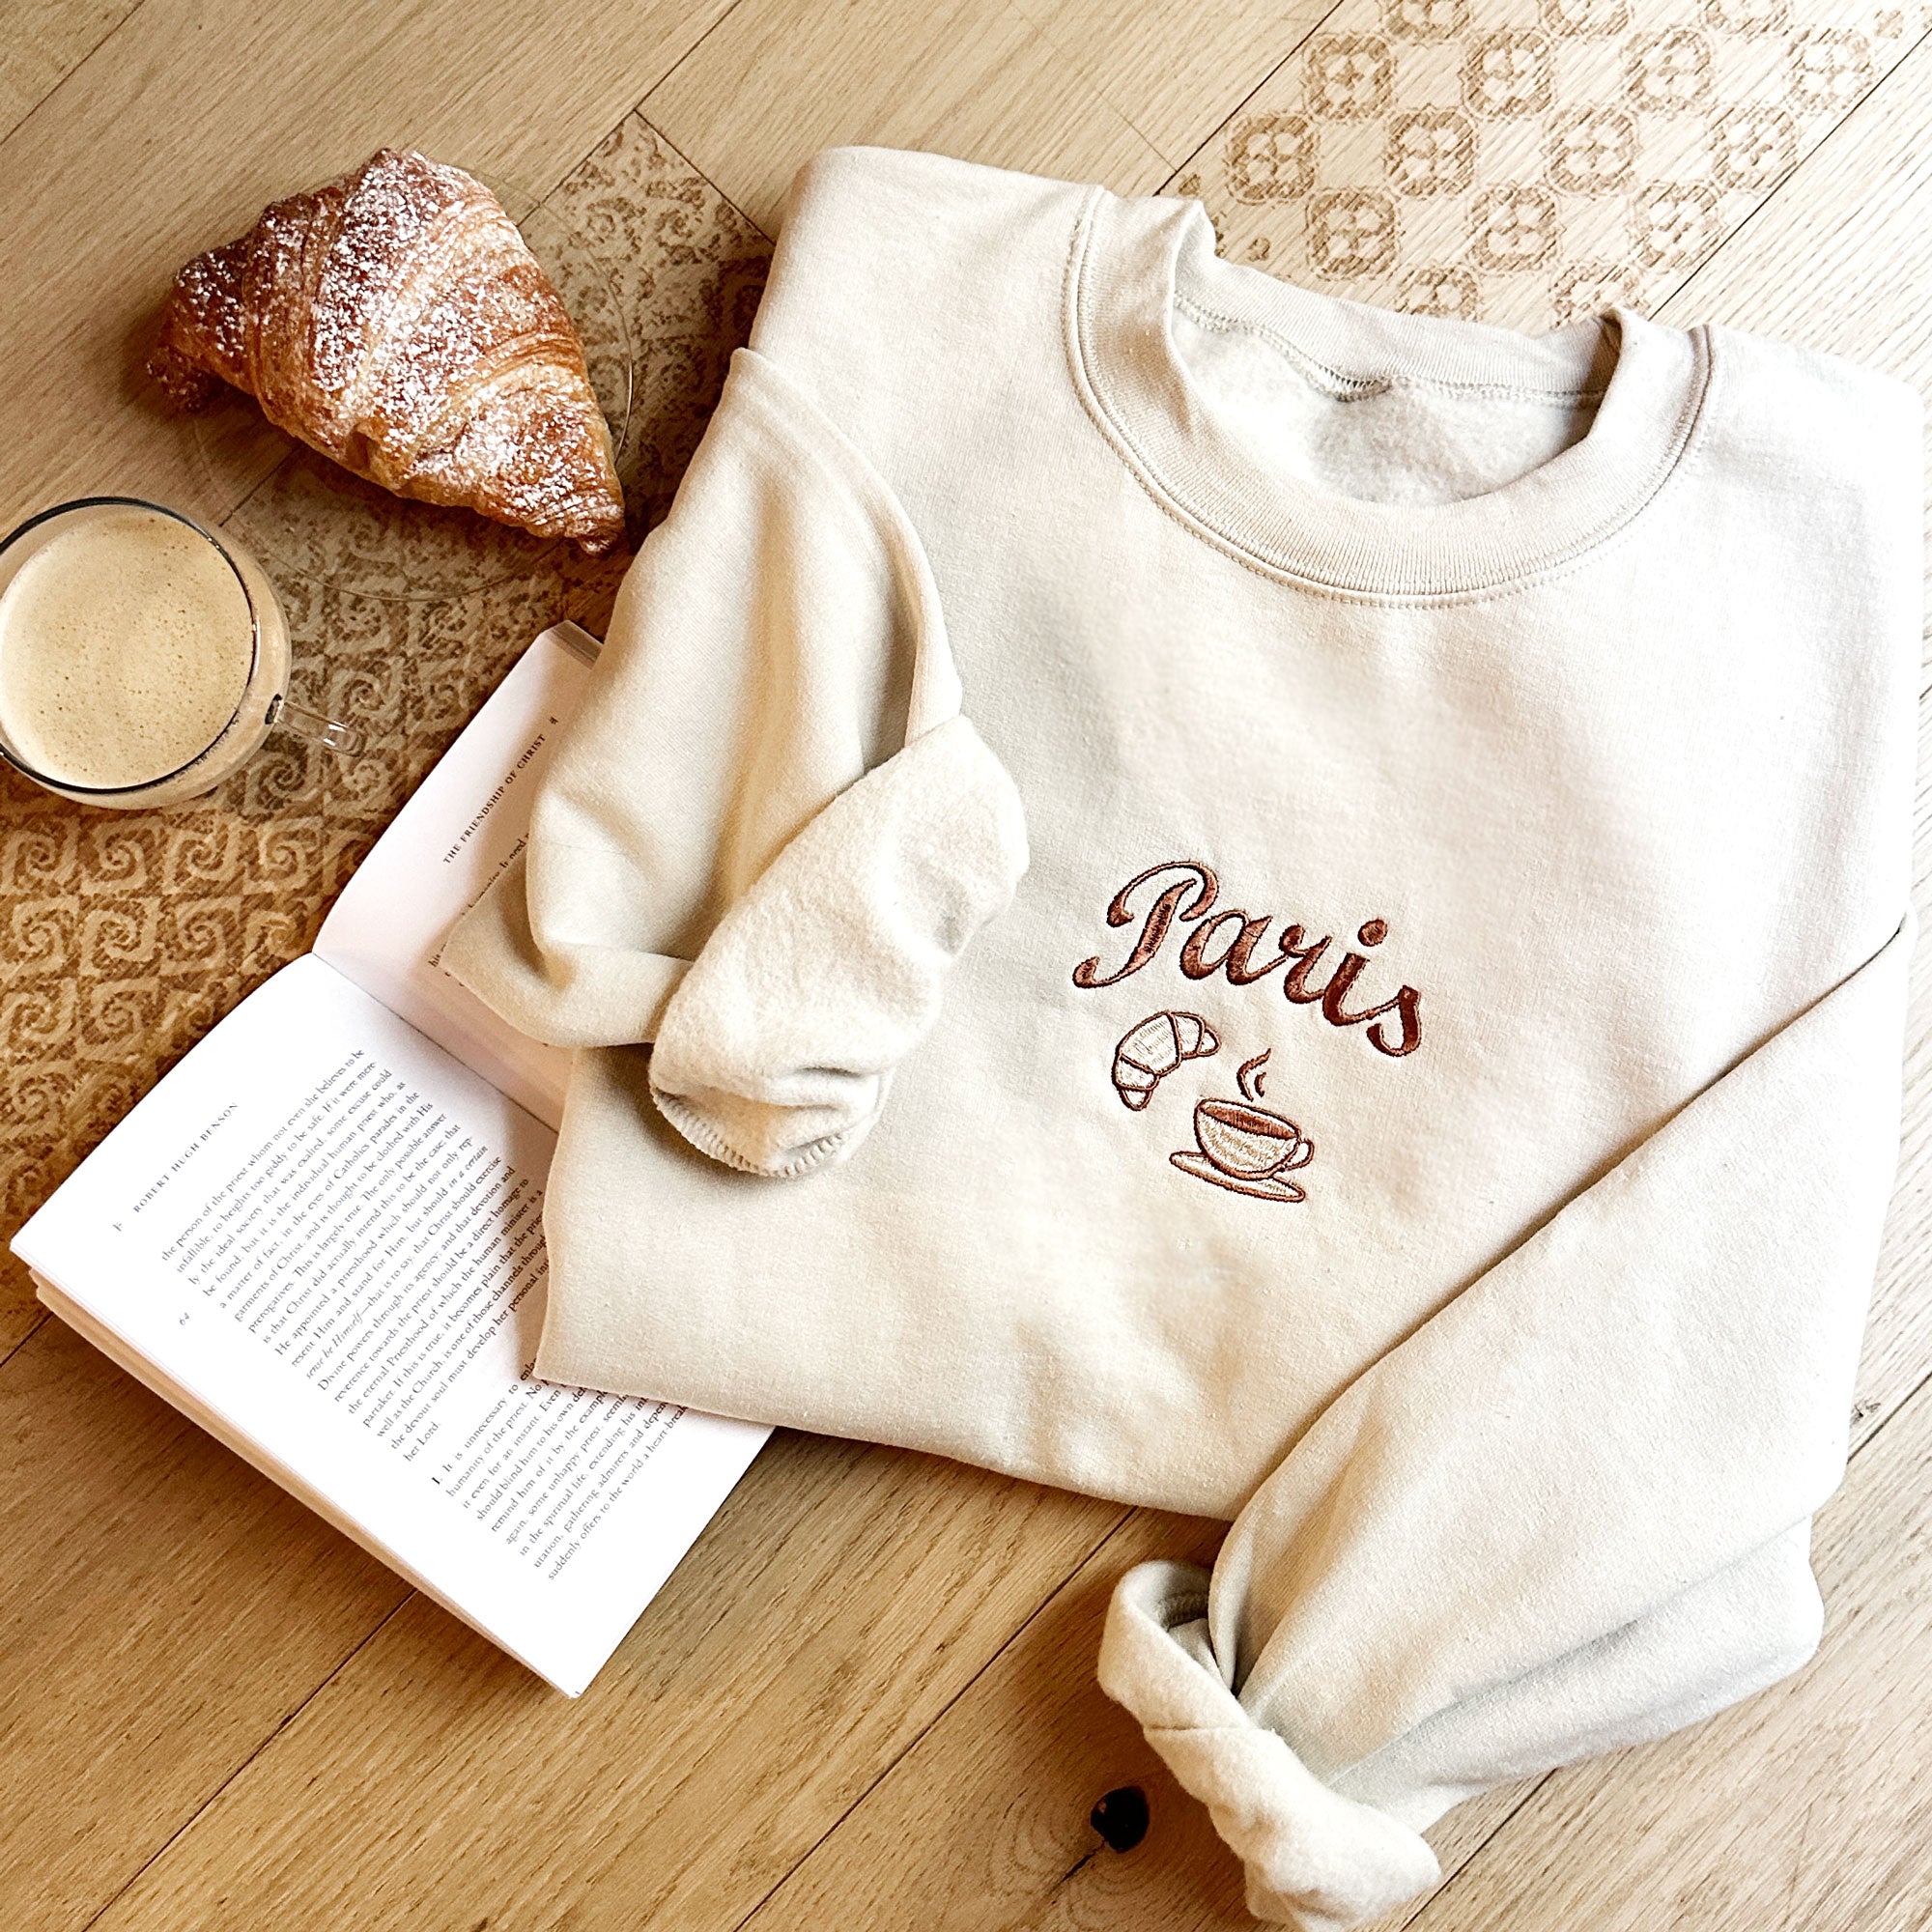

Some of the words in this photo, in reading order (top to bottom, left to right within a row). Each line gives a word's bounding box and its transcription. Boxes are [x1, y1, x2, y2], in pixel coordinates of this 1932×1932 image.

[443, 843, 461, 864] THE
[460, 785, 505, 842] FRIENDSHIP
[504, 770, 518, 784] OF
[516, 733, 546, 769] CHRIST
[1072, 860, 1422, 1057] Paris
[133, 1173, 170, 1212] ROBERT
[171, 1143, 200, 1172] HUGH
[200, 1102, 239, 1142] BENSON
[175, 1217, 203, 1248] person
[225, 1167, 248, 1194] priest
[247, 1141, 273, 1167] whom
[287, 1107, 306, 1126] even
[315, 1067, 347, 1094] believes
[215, 1234, 236, 1258] ideal
[236, 1208, 263, 1234] society
[263, 1186, 281, 1205] that
[327, 1115, 348, 1137] some
[347, 1091, 372, 1115] excuse
[371, 1068, 393, 1092] could
[219, 1192, 251, 1222] heights
[265, 1153, 287, 1179] giddy
[338, 1079, 358, 1097] were
[226, 1271, 253, 1300] matter
[307, 1192, 325, 1210] eyes
[333, 1143, 370, 1179] Catholics
[369, 1114, 398, 1145] parades
[405, 1092, 420, 1105] the
[234, 1281, 270, 1322] garments
[327, 1181, 358, 1215] thought
[376, 1130, 405, 1162] clothed
[402, 1116, 421, 1133] with
[415, 1102, 434, 1118] His
[270, 1316, 288, 1335] that
[285, 1287, 313, 1315] Christ
[311, 1268, 327, 1287] did
[327, 1239, 356, 1271] actually
[355, 1208, 383, 1237] intend
[380, 1194, 397, 1209] this
[414, 1157, 429, 1172] the
[443, 1123, 462, 1140] that
[291, 1158, 330, 1201] individual
[327, 1131, 357, 1160] human
[356, 1109, 379, 1133] priest
[292, 1259, 314, 1277] This
[317, 1225, 345, 1251] largely
[378, 1167, 395, 1186] only
[394, 1137, 424, 1170] possible
[422, 1113, 447, 1139] answer
[291, 1341, 316, 1368] resent
[312, 1318, 336, 1340] Him
[352, 1271, 374, 1298] stand
[422, 1186, 449, 1217] should
[465, 1145, 489, 1171] certain
[292, 1293, 330, 1340] appointed
[337, 1238, 378, 1289] priesthood
[377, 1214, 402, 1239] which
[401, 1183, 428, 1213] should
[441, 1151, 460, 1170] only
[306, 1357, 324, 1379] sense
[412, 1236, 430, 1254] that
[427, 1209, 454, 1236] Christ
[451, 1181, 477, 1211] should
[474, 1156, 502, 1185] exercise
[317, 1360, 347, 1391] Divine
[346, 1330, 374, 1363] powers
[372, 1294, 405, 1329] through
[454, 1215, 472, 1234] that
[469, 1181, 503, 1216] devotion
[499, 1165, 517, 1184] and
[333, 1362, 370, 1403] reverence
[368, 1327, 399, 1362] towards
[411, 1288, 433, 1315] priest
[432, 1257, 459, 1288] should
[471, 1216, 496, 1241] direct
[489, 1184, 523, 1219] homage
[518, 1179, 530, 1189] to
[362, 1365, 390, 1398] eternal
[385, 1318, 430, 1367] Priesthood
[438, 1282, 463, 1308] which
[461, 1266, 476, 1282] the
[471, 1236, 502, 1266] human
[500, 1203, 529, 1236] minister
[523, 1194, 539, 1205] is
[533, 1189, 546, 1199] a
[392, 1378, 404, 1388] If
[402, 1360, 419, 1378] this
[447, 1286, 483, 1322] becomes
[480, 1264, 502, 1289] plain
[498, 1245, 518, 1265] that
[514, 1232, 528, 1249] the
[376, 1416, 394, 1437] well
[471, 1299, 495, 1324] those
[491, 1259, 525, 1302] channels
[404, 1403, 432, 1434] devout
[431, 1380, 449, 1403] soul
[447, 1359, 468, 1383] must
[466, 1325, 497, 1359] develop
[491, 1309, 510, 1326] her
[506, 1269, 540, 1314] personal
[441, 1463, 453, 1473] It
[464, 1400, 507, 1449] unnecessary
[507, 1383, 519, 1395] to
[445, 1456, 484, 1497] humanity
[525, 1382, 543, 1401] No
[470, 1478, 490, 1499] even
[538, 1388, 562, 1412] Even
[476, 1488, 503, 1520] should
[497, 1463, 524, 1491] blind
[556, 1403, 575, 1423] own
[491, 1497, 519, 1533] remind
[527, 1492, 549, 1517] some
[548, 1454, 581, 1491] unhappy
[543, 1488, 574, 1527] spiritual
[588, 1427, 625, 1470] extending
[620, 1411, 637, 1427] his
[548, 1542, 581, 1580] suddenly
[580, 1515, 602, 1540] offers
[621, 1458, 644, 1486] world
[563, 1489, 600, 1533] gathering
[598, 1450, 629, 1489] admirers
